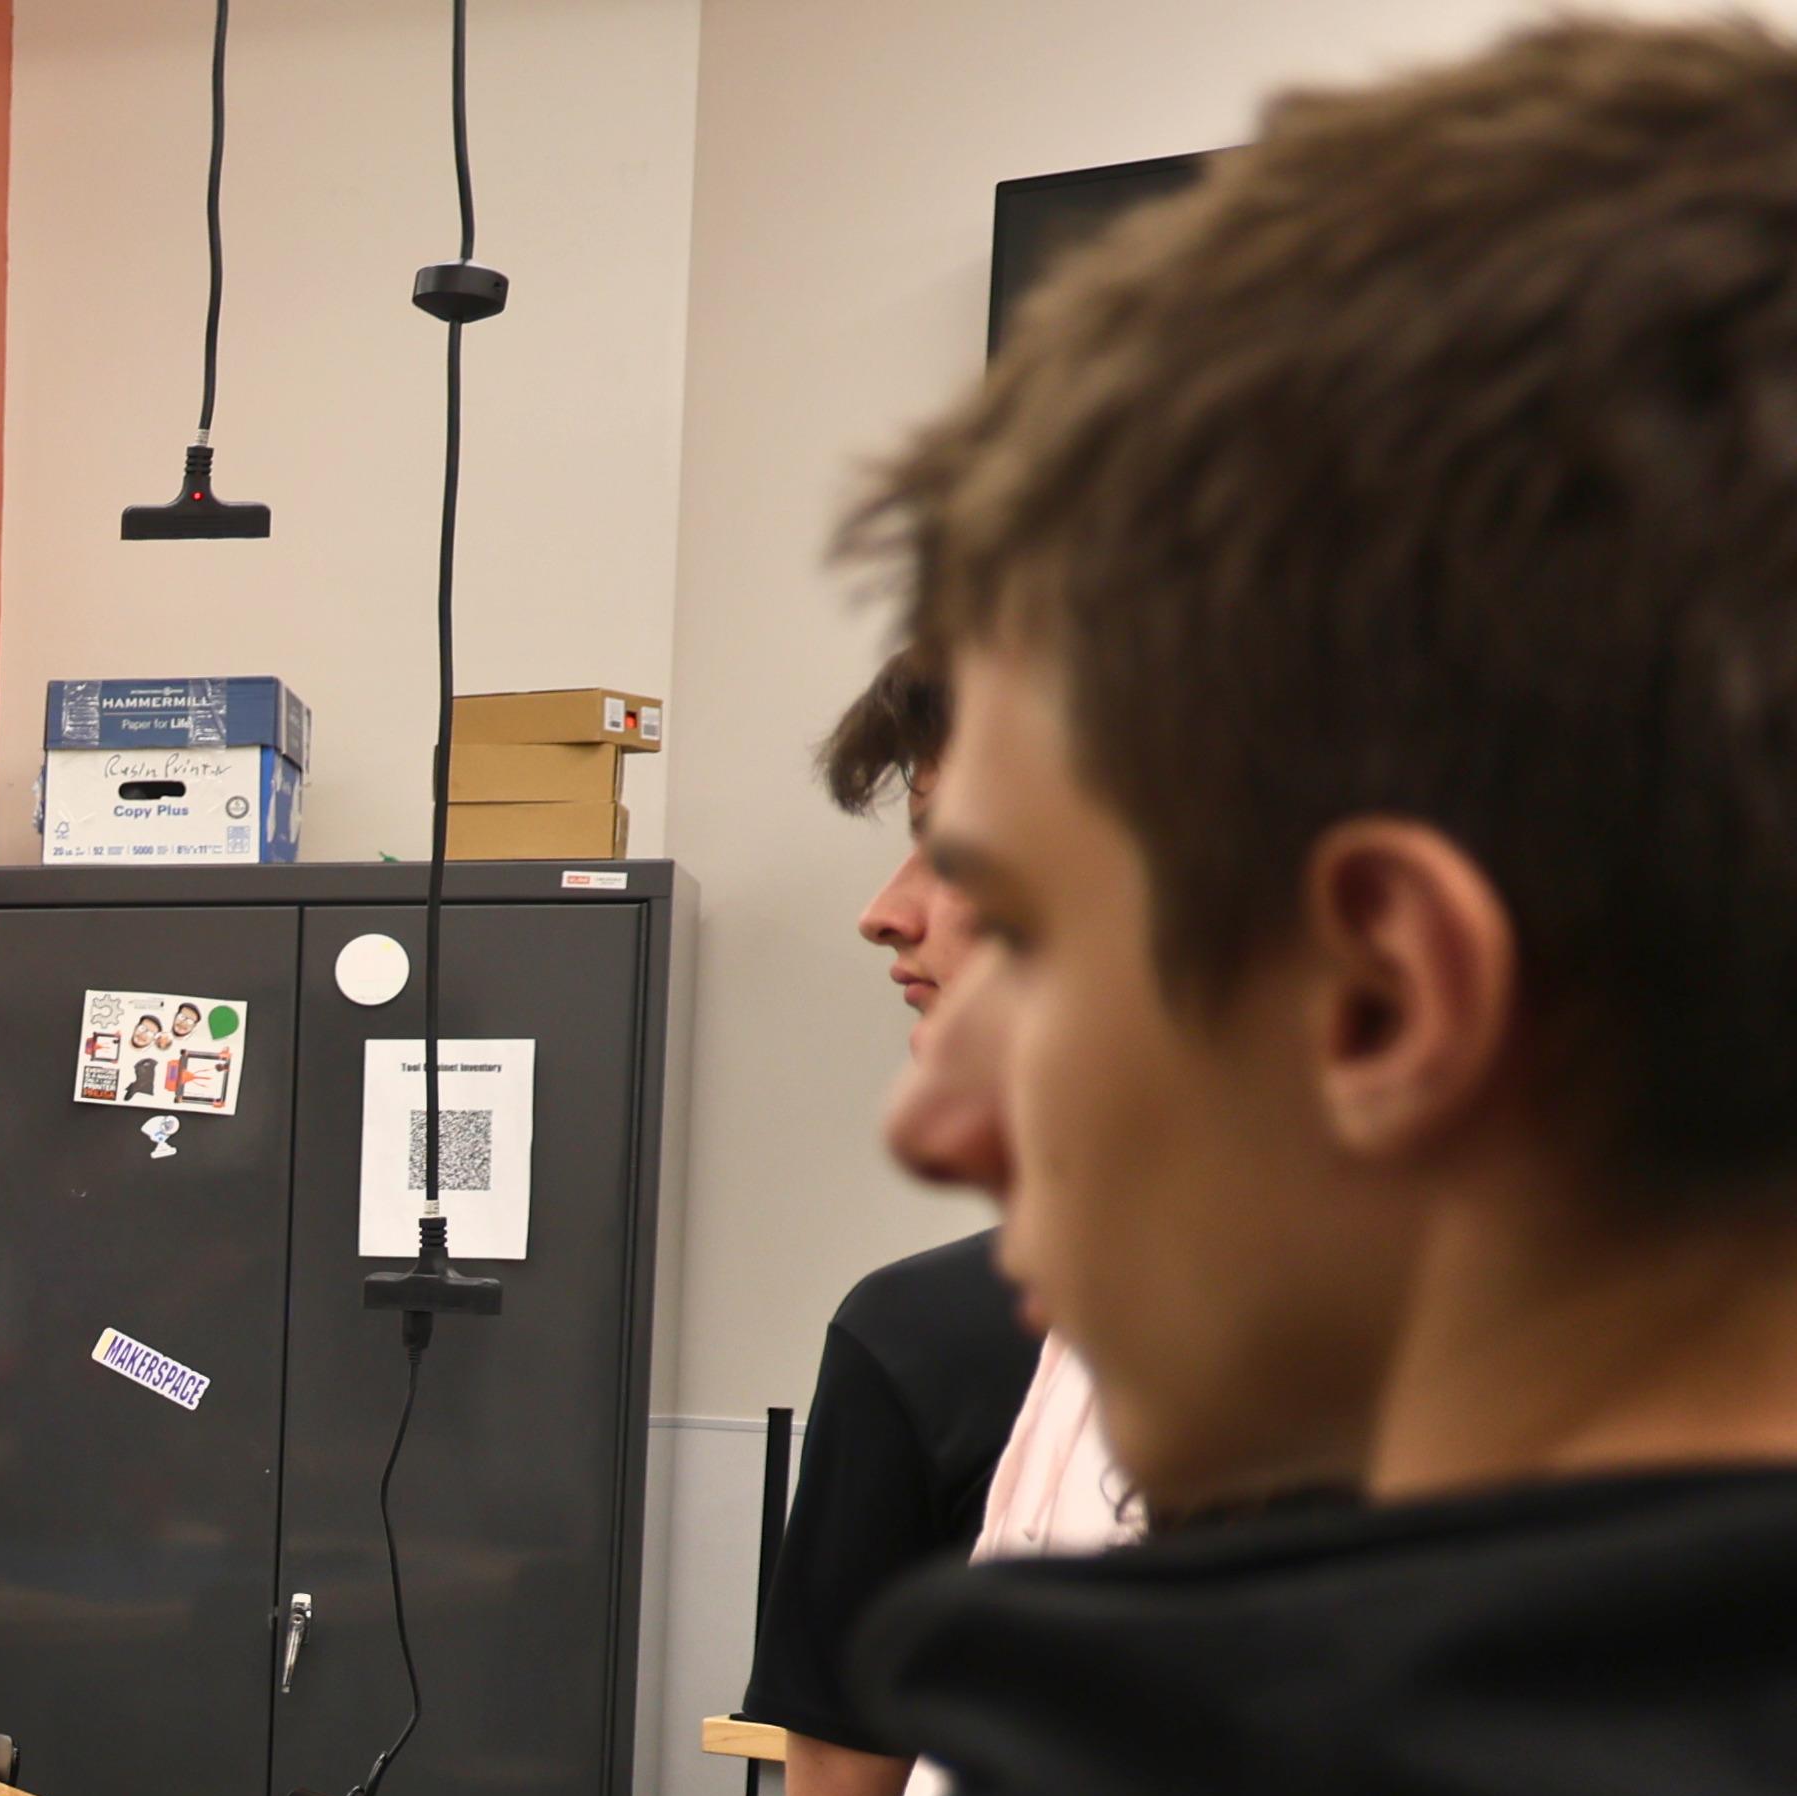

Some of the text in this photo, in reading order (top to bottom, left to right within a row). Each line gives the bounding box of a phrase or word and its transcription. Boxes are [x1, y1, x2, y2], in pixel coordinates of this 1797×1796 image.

[113, 803, 189, 818] Copy Plus
[401, 1062, 421, 1072] Tool
[460, 1063, 502, 1073] Inventory
[103, 1335, 205, 1406] MAKERSPACE
